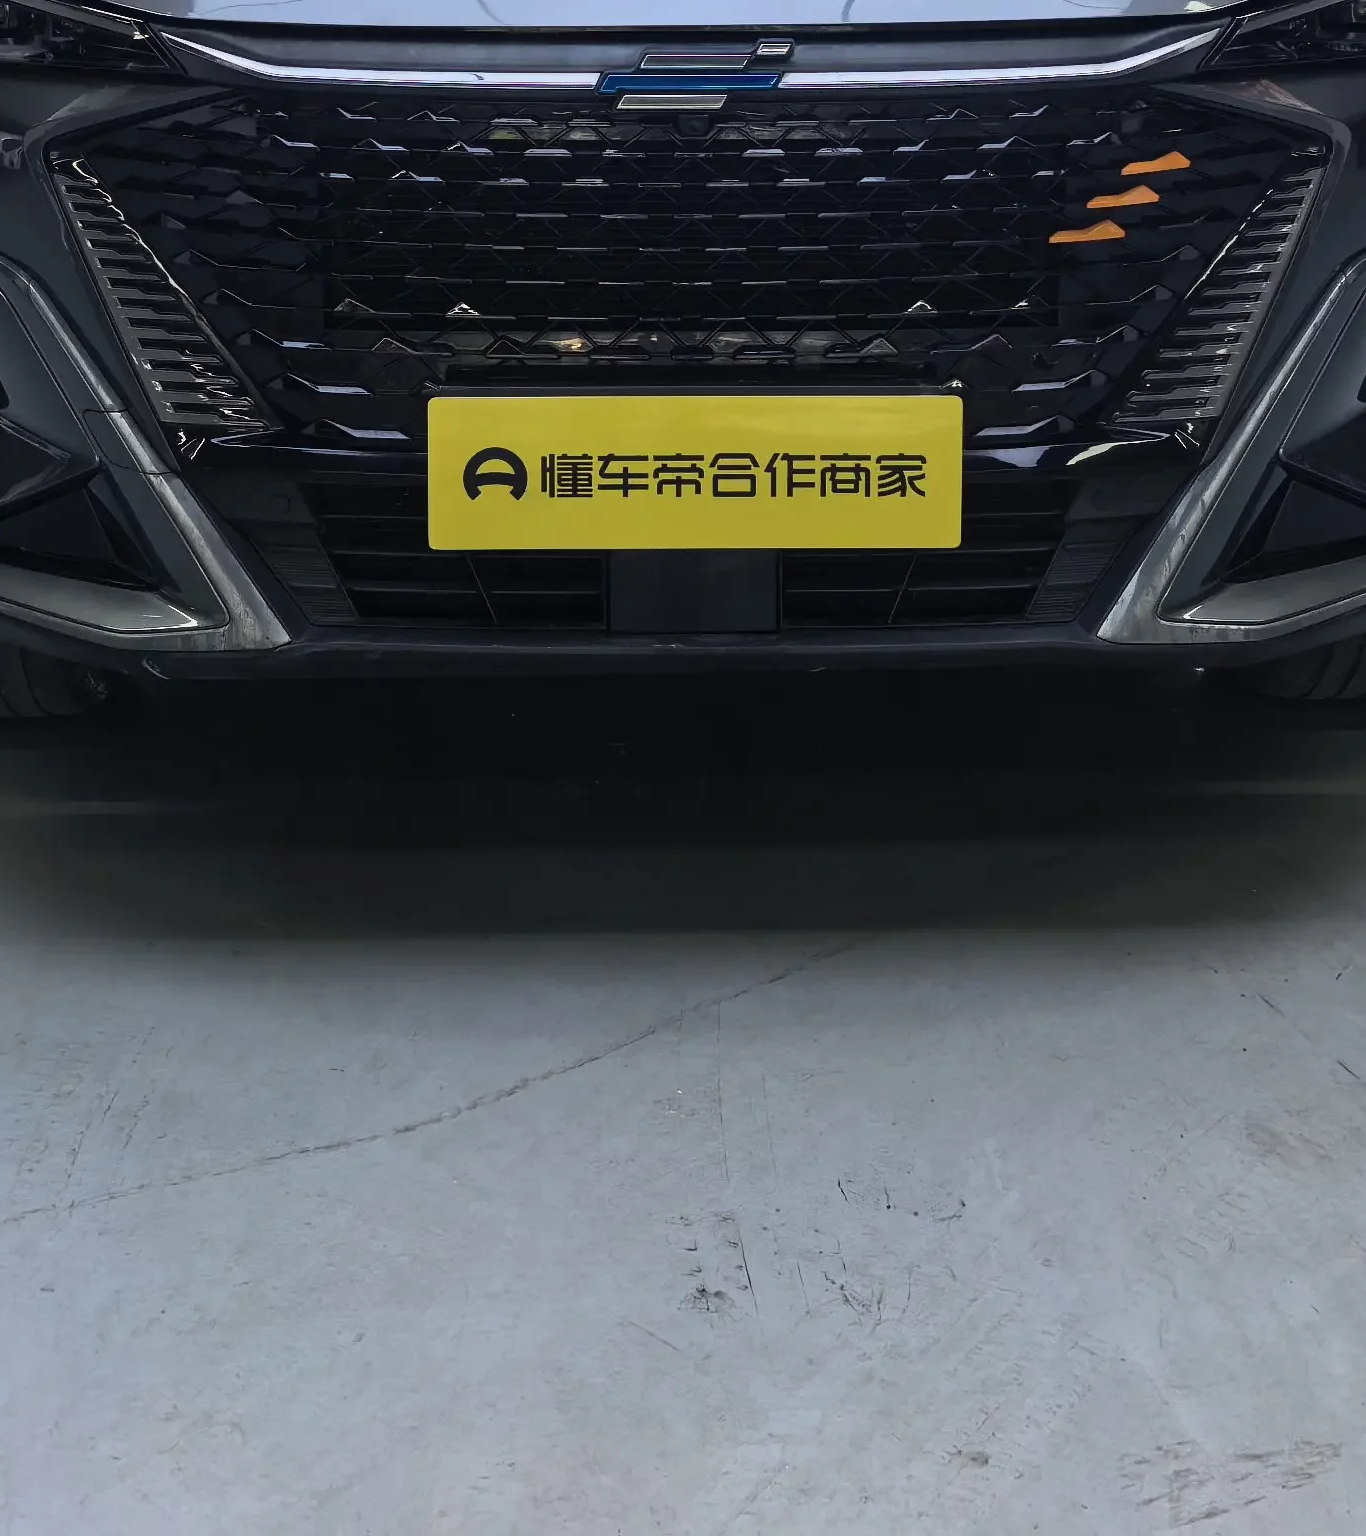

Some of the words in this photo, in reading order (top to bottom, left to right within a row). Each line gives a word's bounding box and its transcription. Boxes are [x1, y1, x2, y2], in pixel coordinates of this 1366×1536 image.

[540, 452, 928, 499] 懂车帝合作商家
